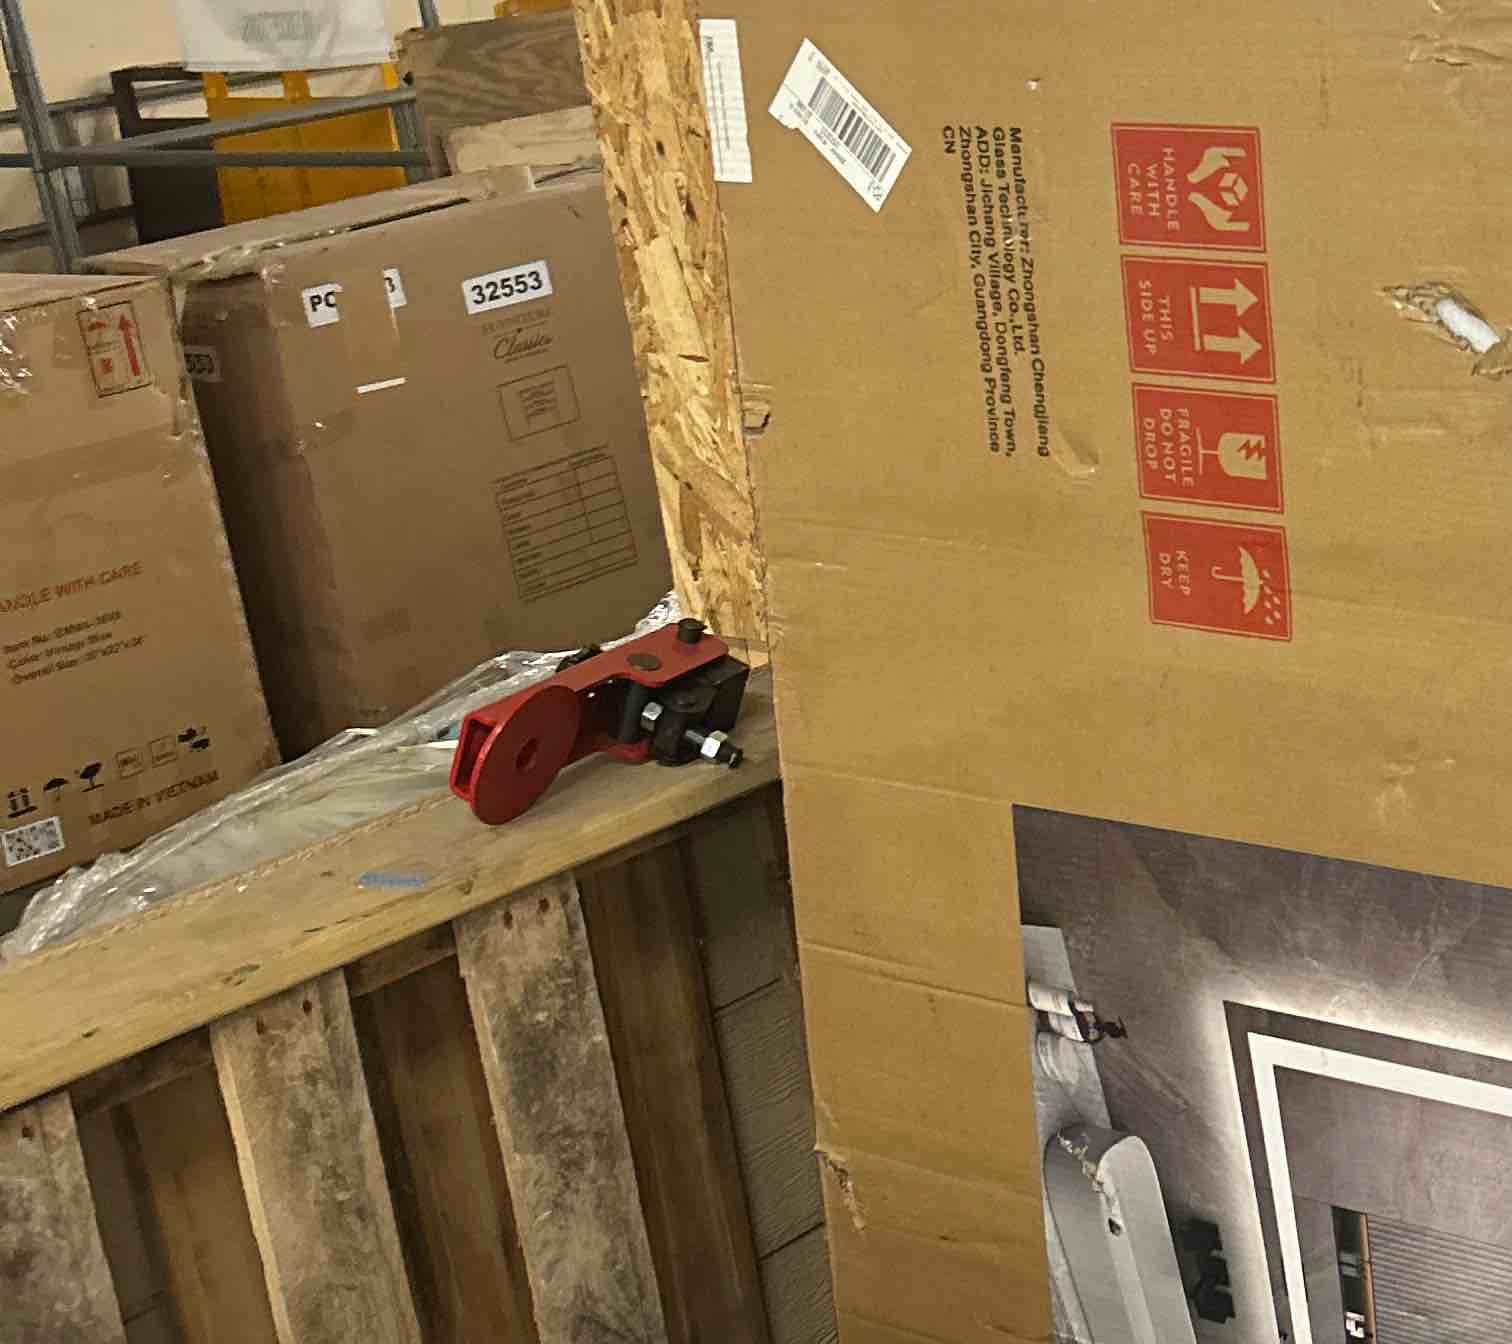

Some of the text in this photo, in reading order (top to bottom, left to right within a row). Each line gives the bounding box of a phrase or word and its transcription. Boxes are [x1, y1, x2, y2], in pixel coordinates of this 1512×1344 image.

[940, 124, 957, 154] CN
[1126, 162, 1144, 217] CARE
[1144, 164, 1161, 218] WITH
[1161, 145, 1182, 232] HANDLE
[471, 271, 543, 305] 32553
[1137, 279, 1158, 356] SIDE UP
[1157, 294, 1174, 342] THIS
[1142, 417, 1159, 471] DROP
[1159, 407, 1177, 485] DO NOT
[1175, 407, 1195, 488] FRAGILE
[1157, 551, 1175, 590] DRY
[1175, 549, 1192, 597] KEEP
